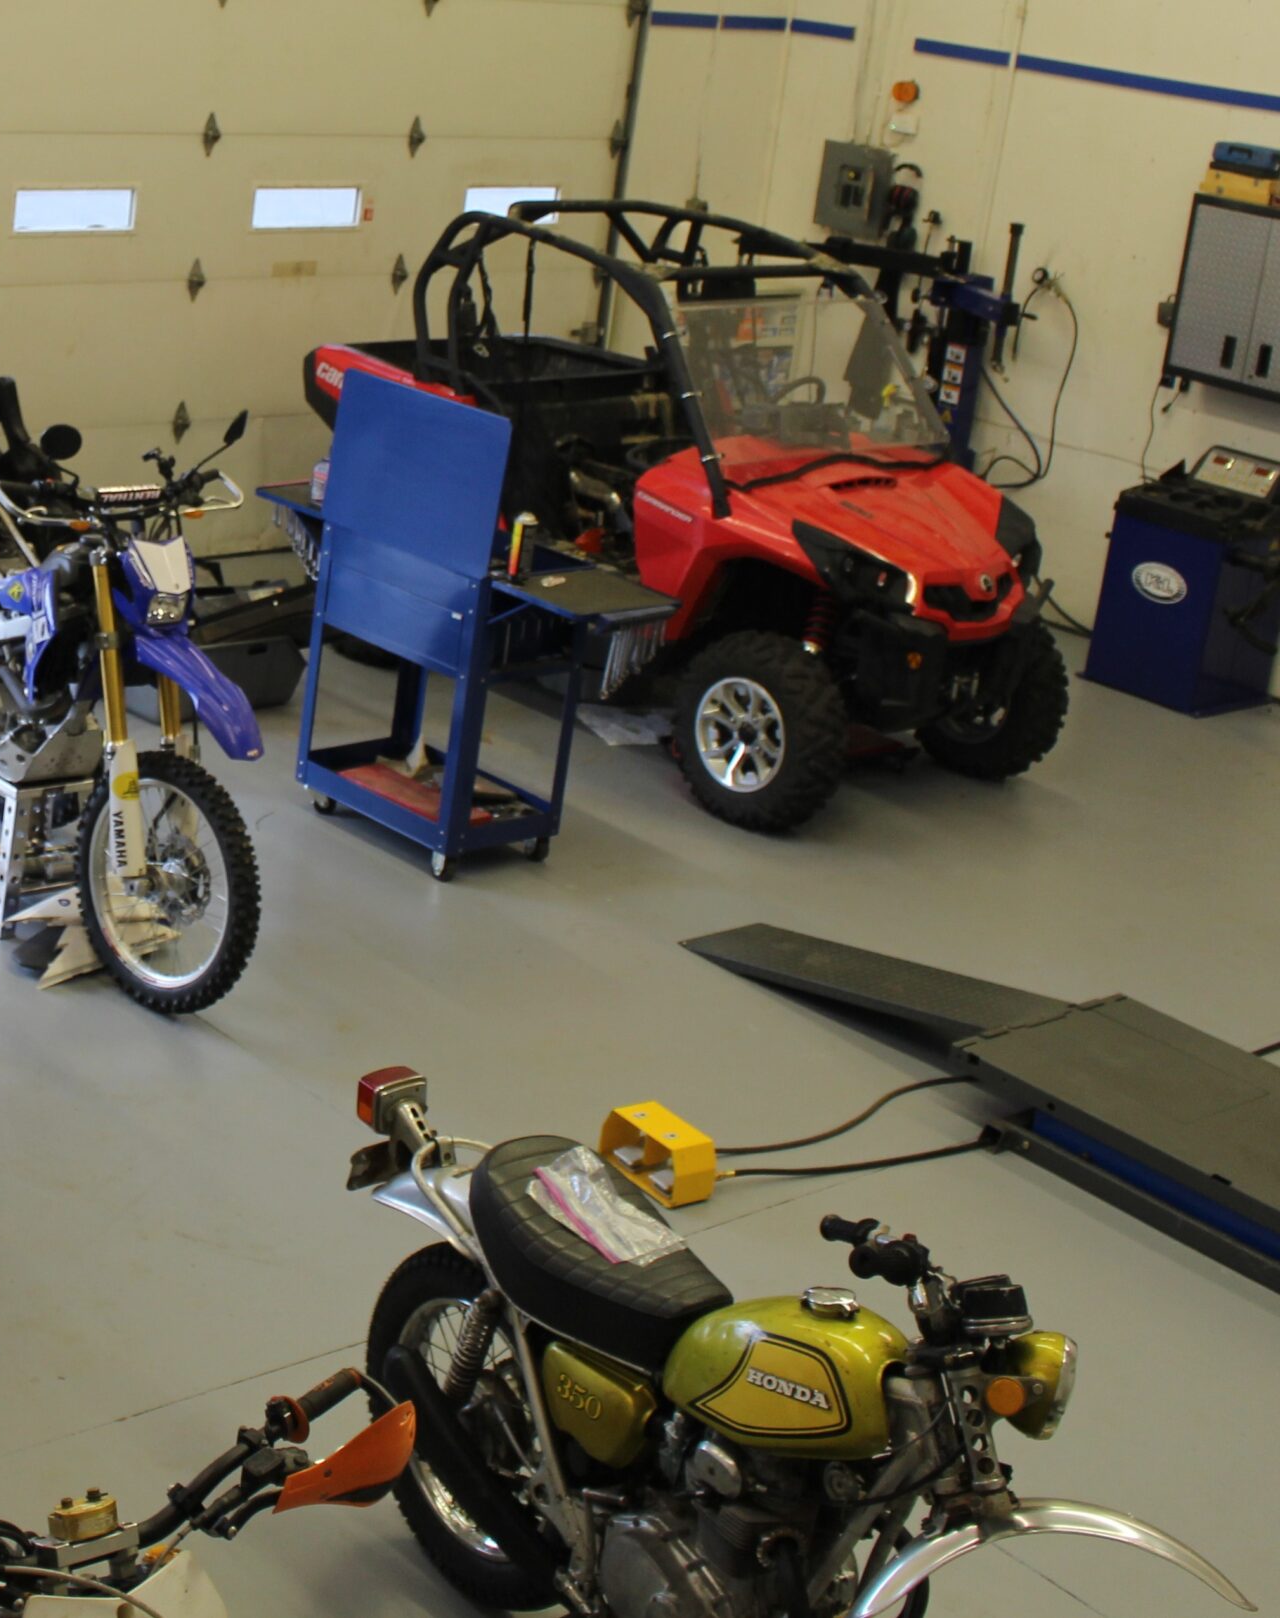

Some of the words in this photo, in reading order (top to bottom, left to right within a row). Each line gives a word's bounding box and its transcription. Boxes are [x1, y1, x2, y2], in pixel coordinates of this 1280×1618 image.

[112, 811, 128, 868] YAMAHA
[557, 1373, 602, 1420] 350
[746, 1367, 832, 1411] HONDA
